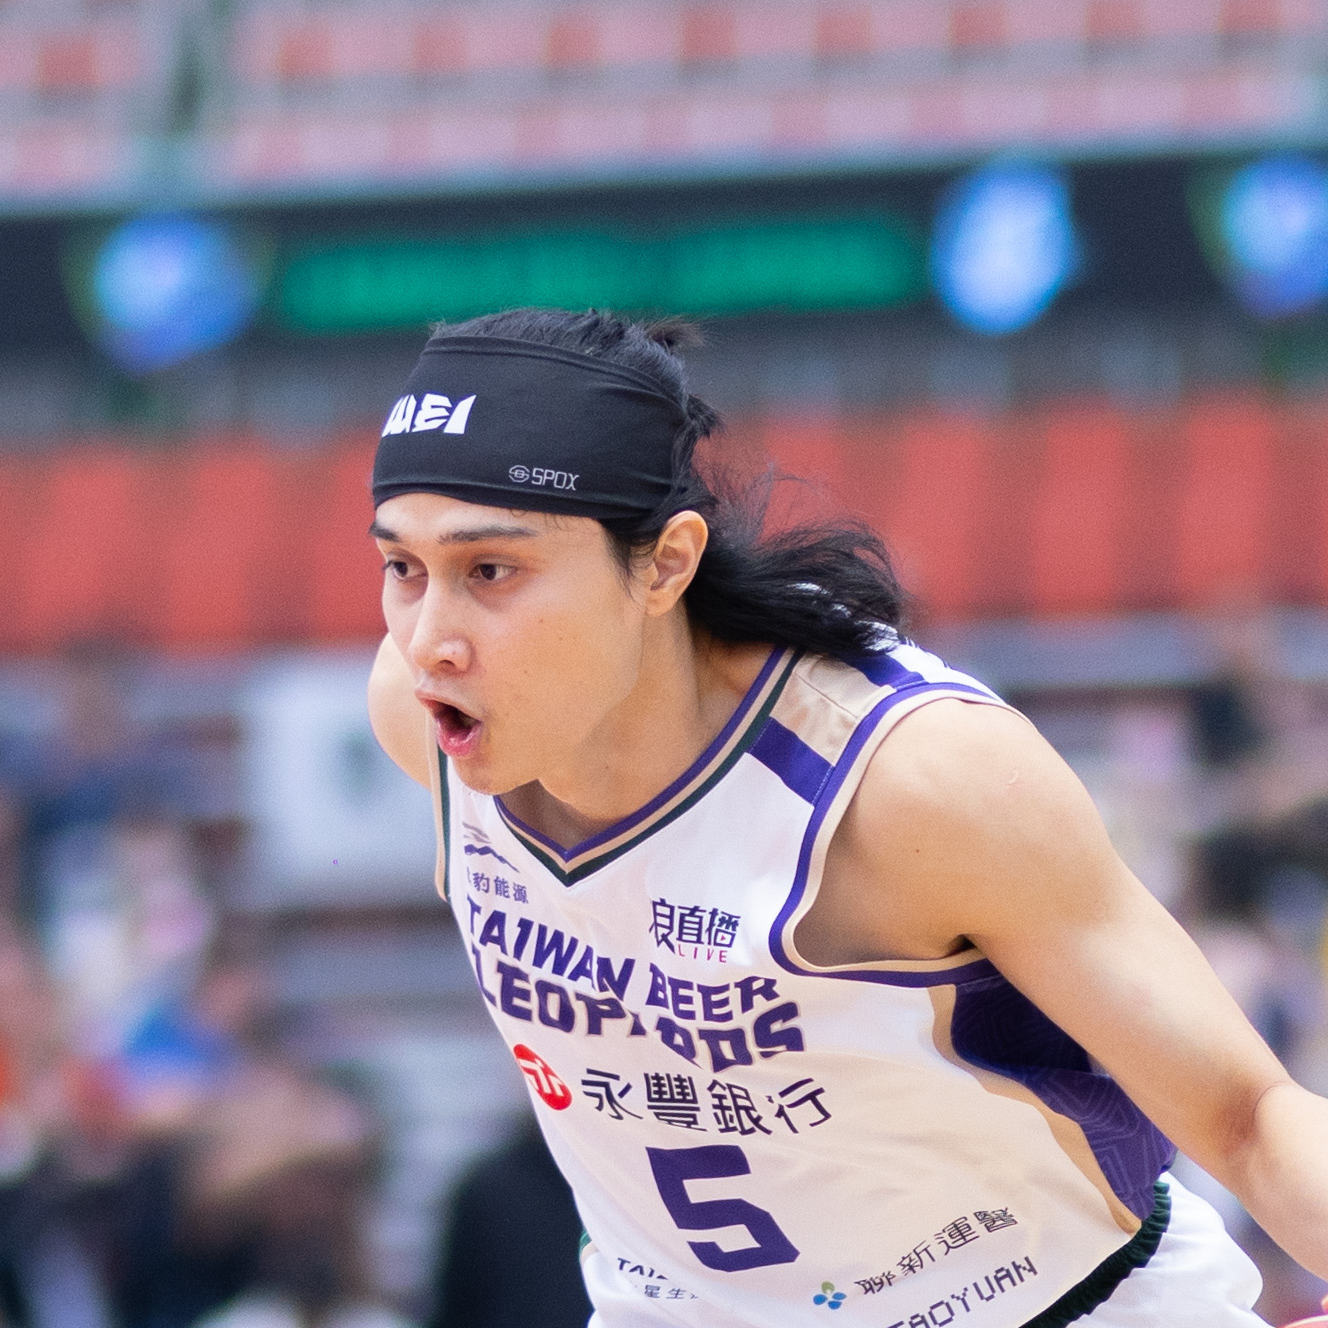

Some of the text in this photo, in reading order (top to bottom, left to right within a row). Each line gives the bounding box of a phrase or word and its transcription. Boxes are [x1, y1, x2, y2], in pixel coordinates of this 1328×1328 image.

[531, 467, 580, 491] SPOX
[466, 866, 529, 904] 豹能源
[648, 898, 741, 954] 良直播
[678, 944, 728, 963] LIVE
[467, 893, 781, 1024] TAIWAN BEER
[581, 1067, 832, 1136] 永豐銀行
[645, 1145, 801, 1273] 5
